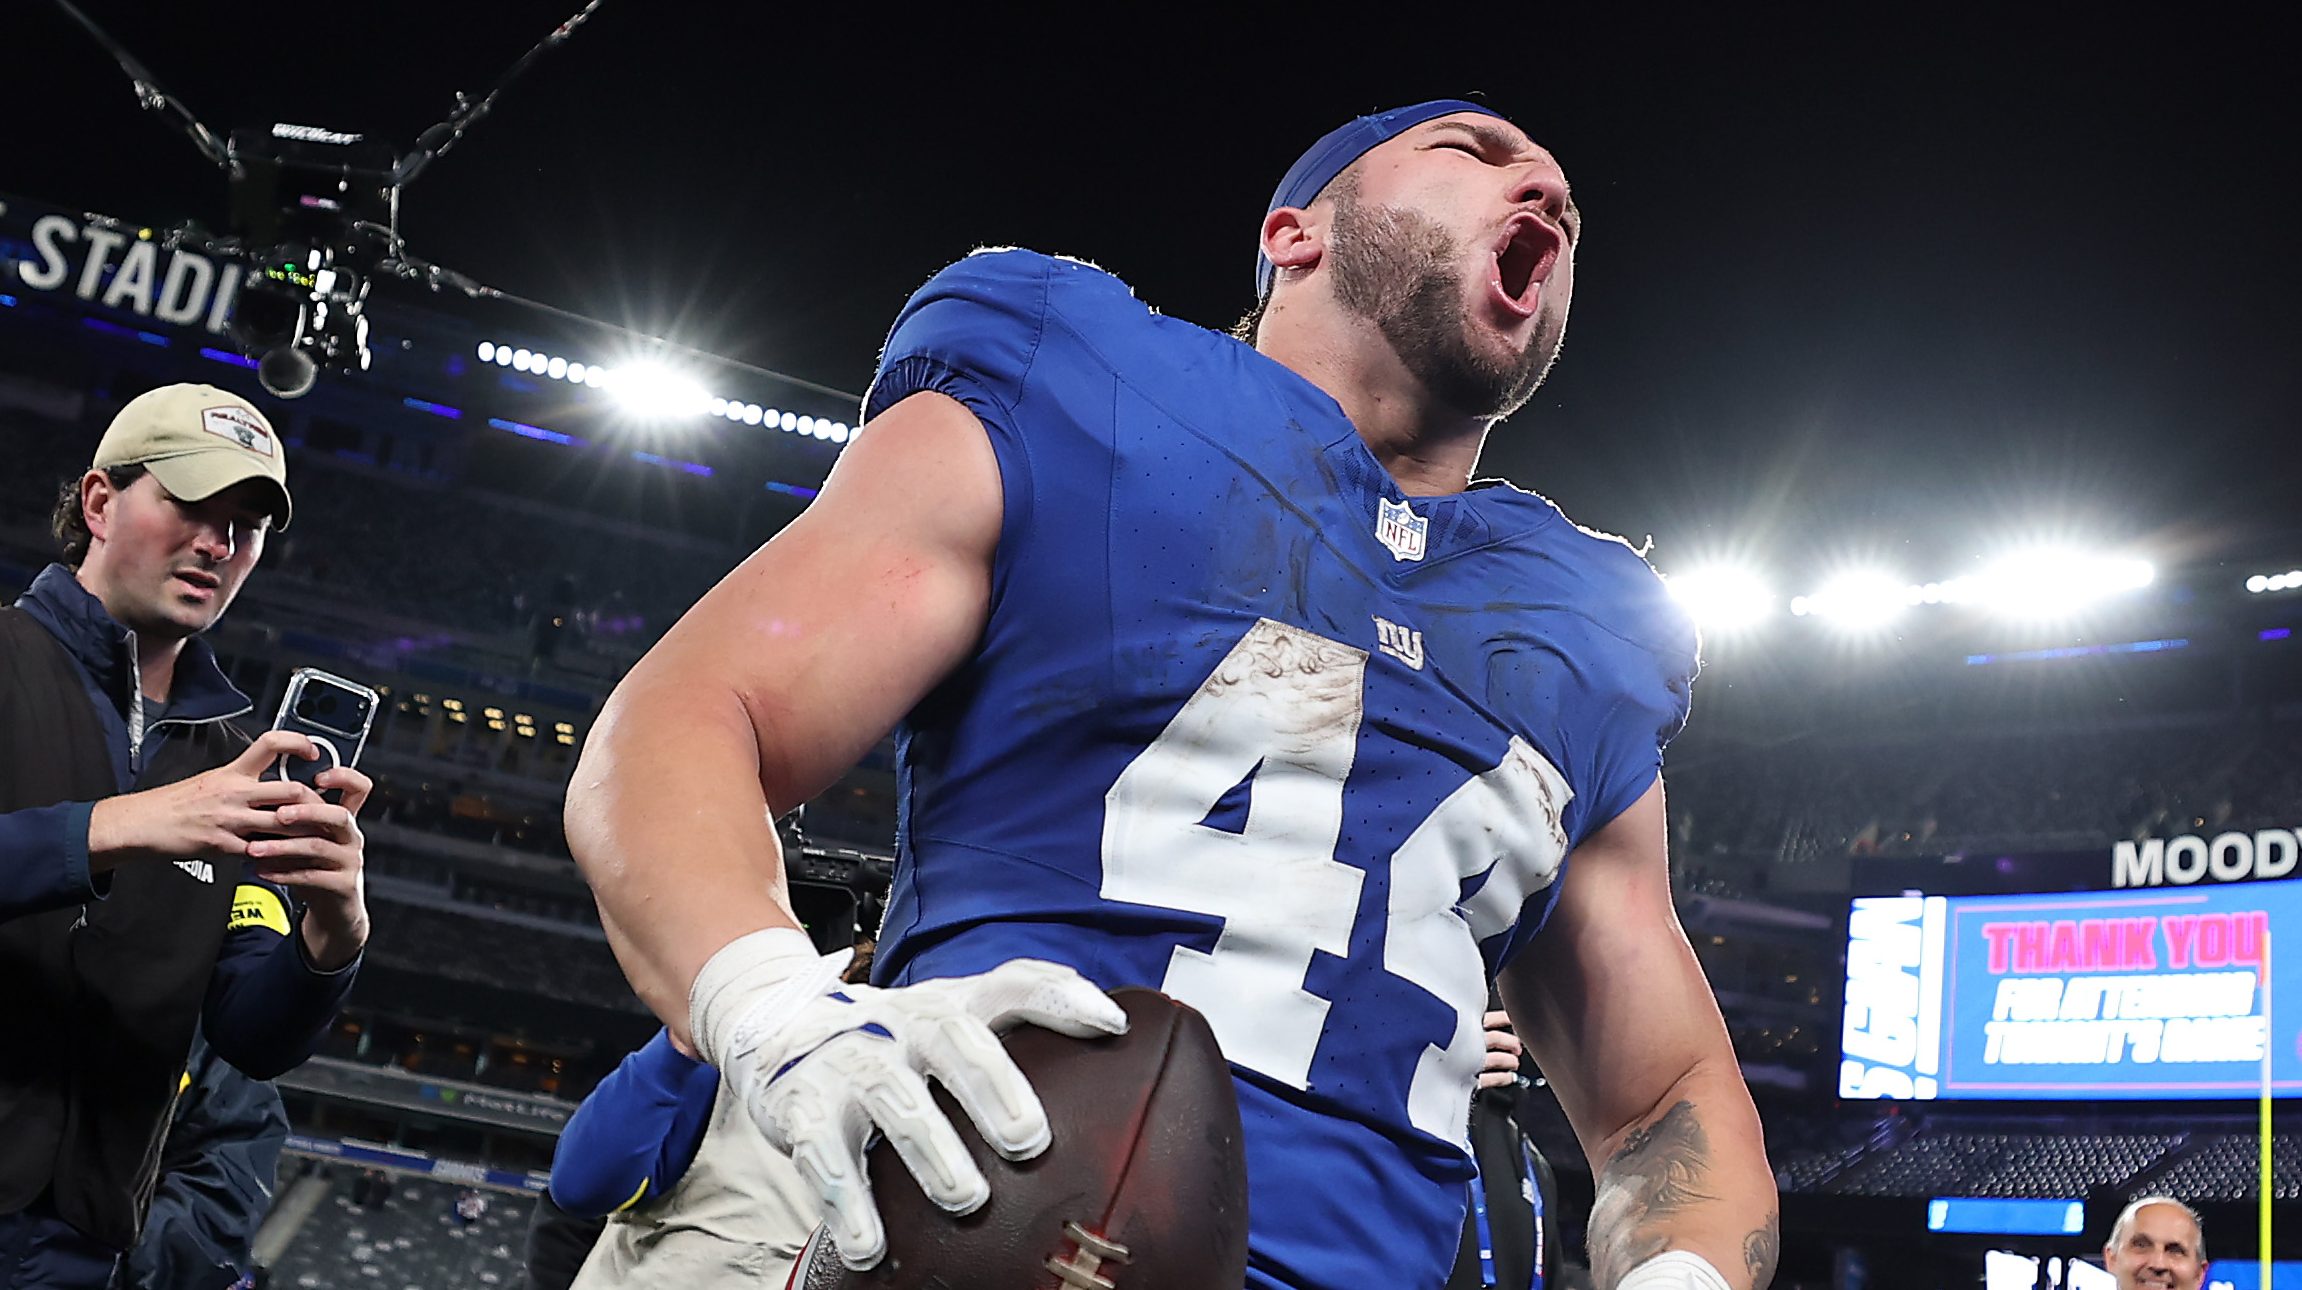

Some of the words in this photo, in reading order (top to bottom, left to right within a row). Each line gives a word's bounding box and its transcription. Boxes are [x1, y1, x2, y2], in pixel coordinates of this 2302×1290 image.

[19, 214, 243, 334] STADI
[1386, 520, 1418, 551] NFL
[1982, 917, 2158, 974] THANK
[2162, 910, 2268, 968] YOU
